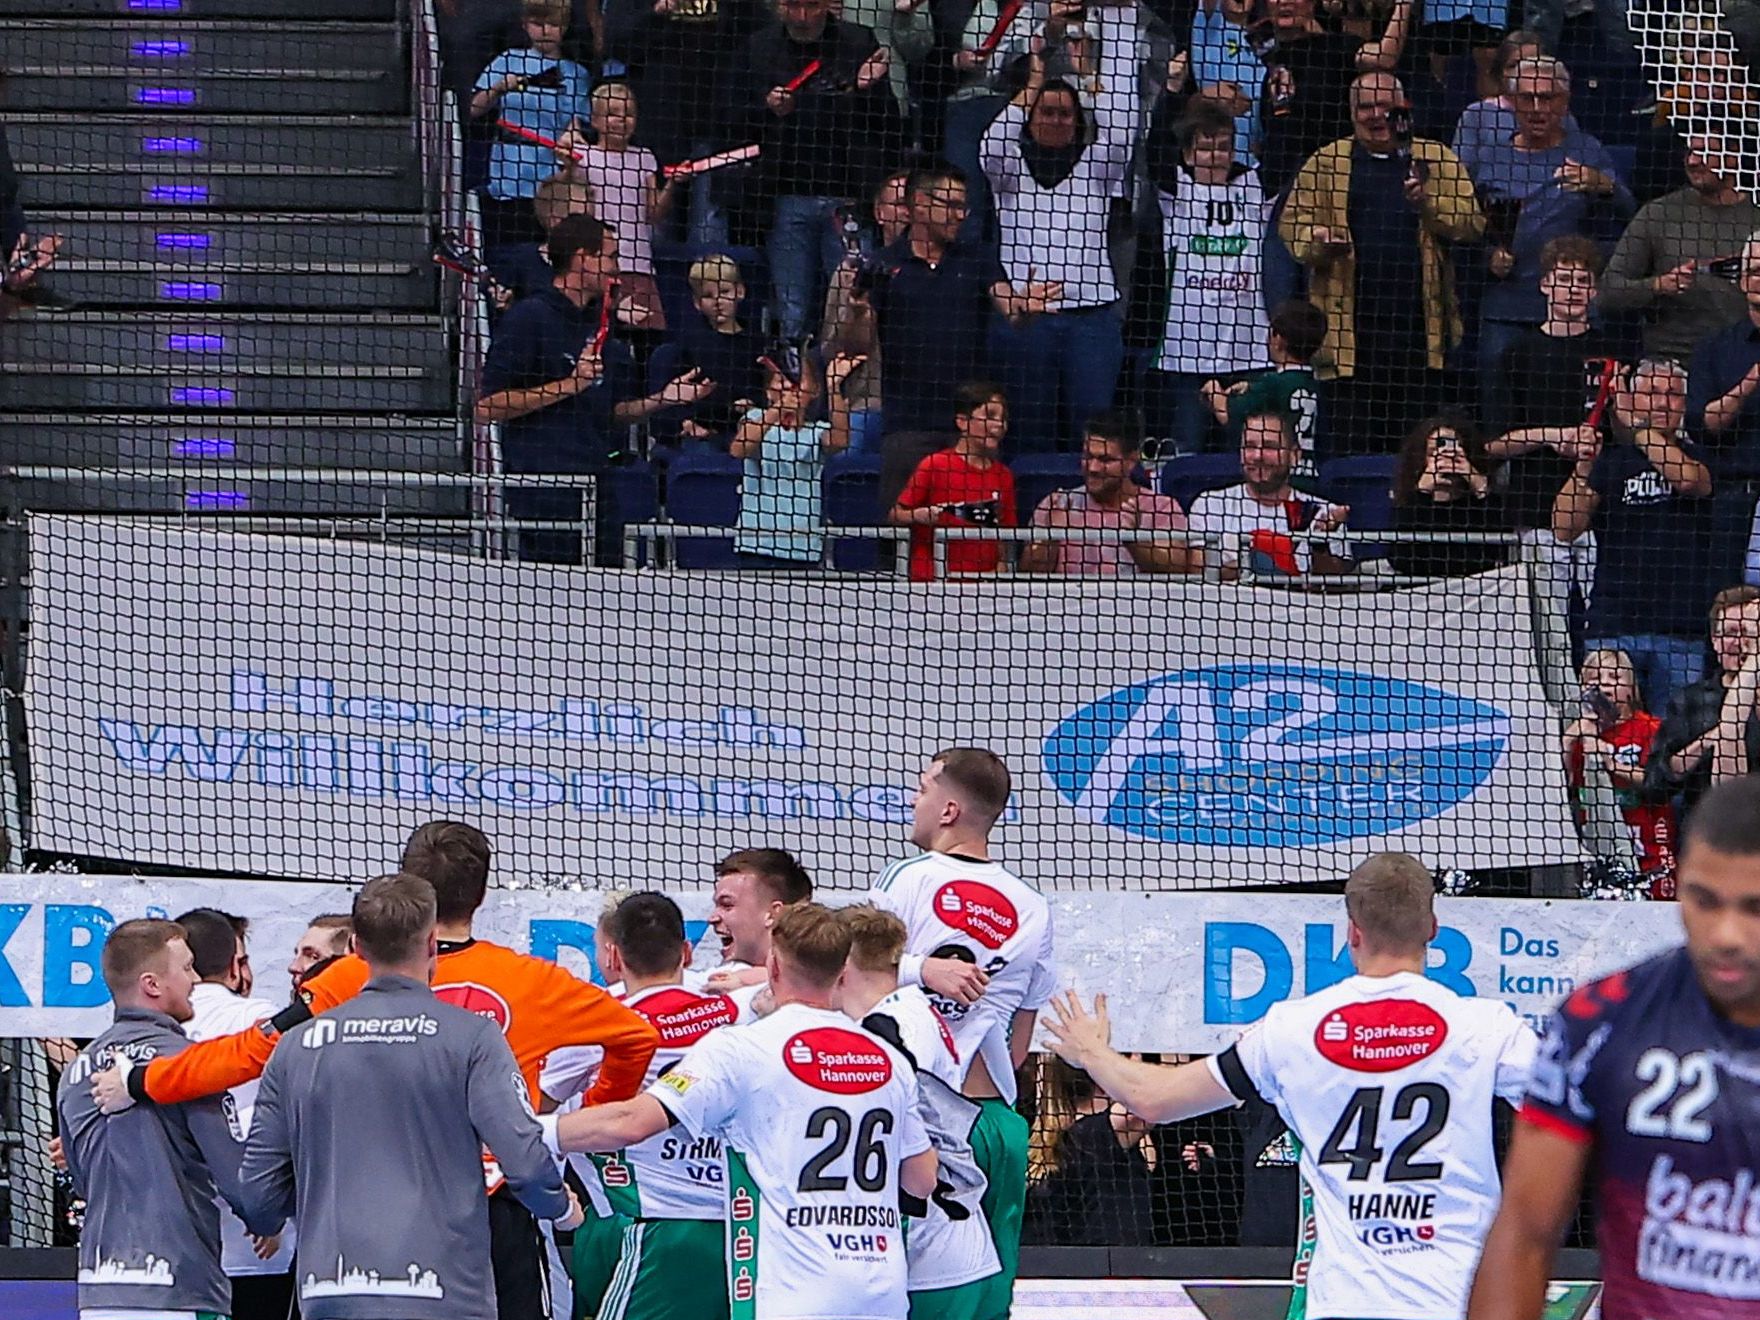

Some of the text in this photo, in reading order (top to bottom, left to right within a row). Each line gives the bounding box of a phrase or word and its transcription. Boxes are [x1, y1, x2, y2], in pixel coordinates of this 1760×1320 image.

[232, 669, 806, 751] Herzlich
[97, 717, 1018, 823] Willkomme
[1147, 780, 1424, 823] CENTER
[965, 900, 1013, 928] Sparkasse
[1500, 927, 1560, 957] Das
[1500, 965, 1575, 995] kann
[342, 1014, 439, 1035] meravis
[656, 1000, 727, 1025] Sparkasse
[661, 1013, 732, 1041] Hannover
[1353, 1024, 1436, 1041] Sparkasse
[816, 1050, 886, 1067] Sparkasse
[1352, 1041, 1430, 1060] Hannover
[820, 1068, 886, 1083] Hannover
[1626, 1047, 1719, 1143] 22
[1317, 1081, 1451, 1183] 42
[796, 1106, 894, 1192] 26
[686, 1164, 723, 1183] VG
[1349, 1194, 1437, 1220] HANNE
[826, 1233, 874, 1252] VGH
